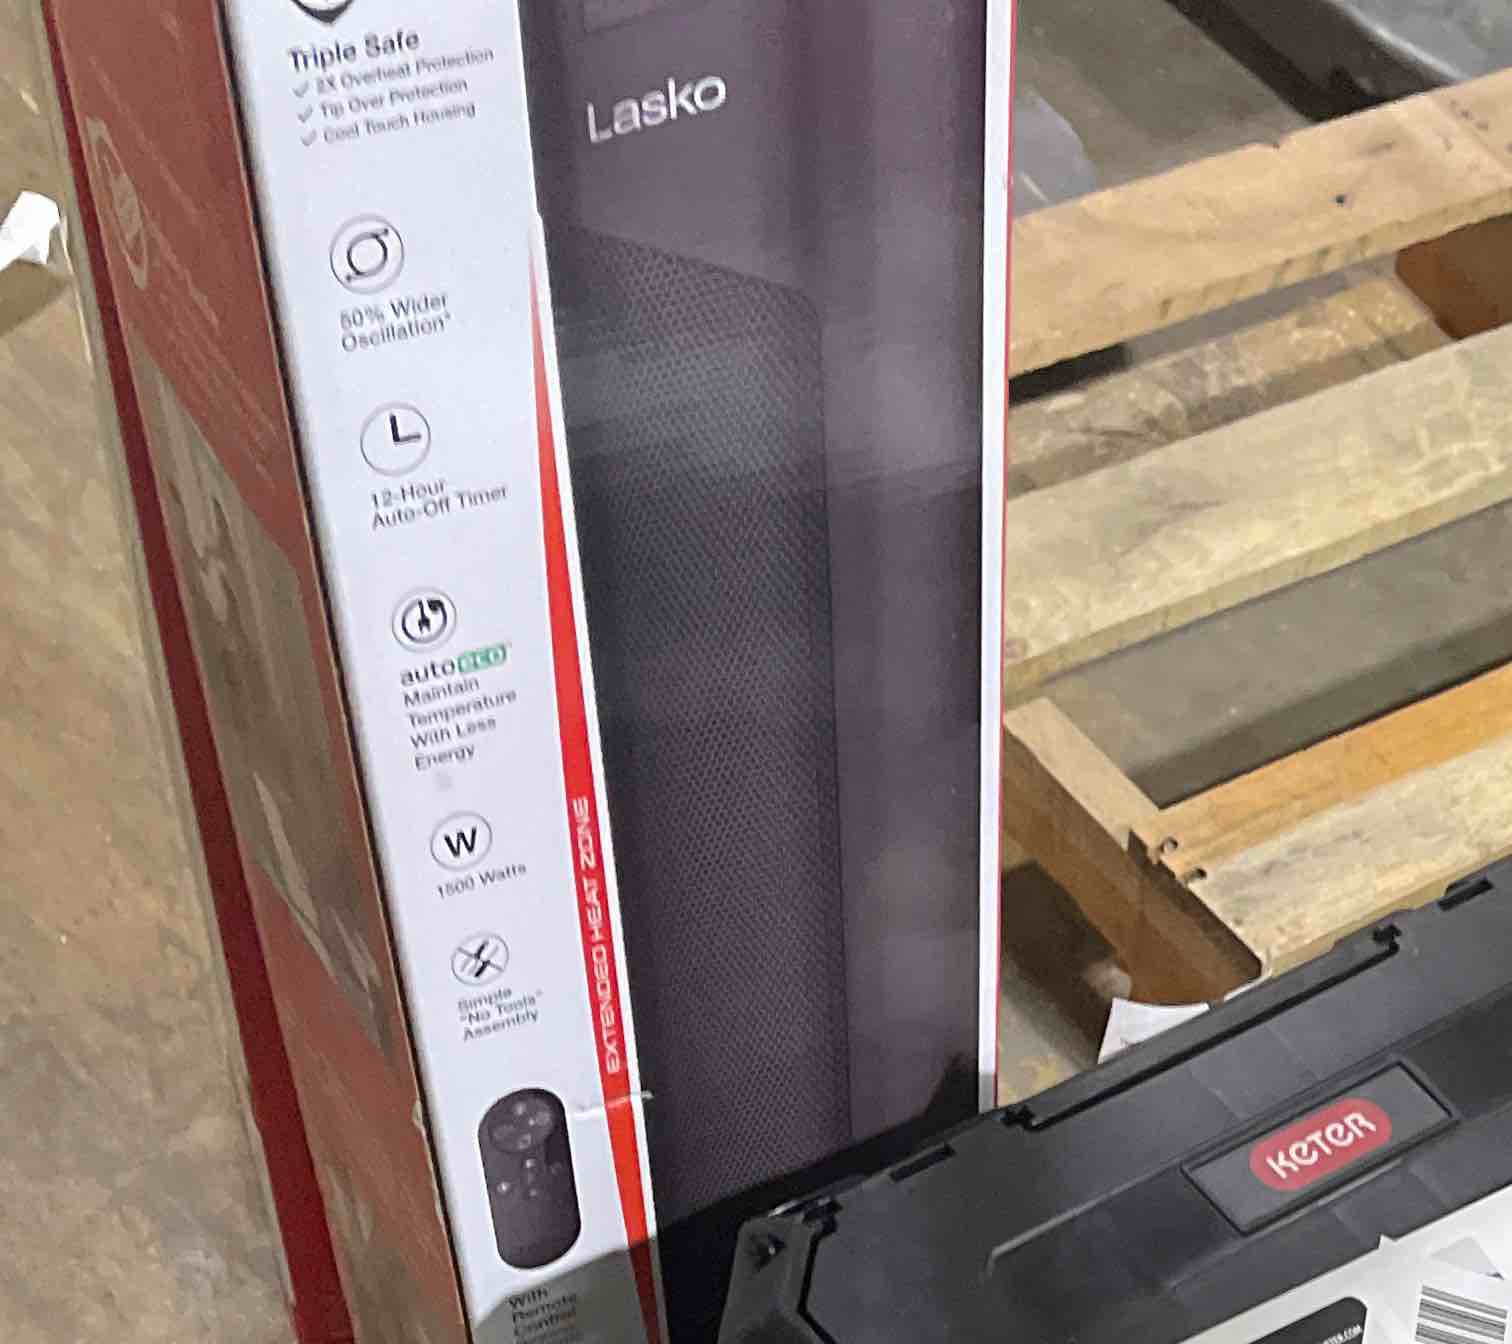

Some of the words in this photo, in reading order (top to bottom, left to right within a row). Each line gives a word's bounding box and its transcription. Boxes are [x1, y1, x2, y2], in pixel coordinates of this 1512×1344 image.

[288, 40, 357, 72] Triple
[364, 29, 420, 58] Safe
[340, 63, 412, 89] Overheat
[415, 46, 495, 75] Protection
[321, 101, 344, 118] Tip
[348, 95, 384, 113] Over
[389, 78, 469, 106] Protection
[585, 75, 728, 143] Lasko
[323, 124, 360, 144] Cool
[365, 115, 410, 135] Touch
[413, 102, 476, 125] Housing
[388, 294, 448, 318] Wider
[371, 480, 447, 509] 12-Hour
[372, 502, 450, 531] Auto-Off
[456, 485, 509, 510] Timer
[404, 677, 480, 707] Maintain
[407, 689, 517, 728] Temperature
[410, 725, 451, 750] With
[456, 716, 496, 739] Less
[414, 745, 476, 771] Energy
[444, 827, 477, 857] W
[572, 796, 596, 871] ZONE
[437, 877, 475, 899] 1500
[478, 863, 527, 887] Watts
[583, 875, 607, 942] HEAT
[463, 1009, 539, 1041] Assembly
[591, 943, 620, 1074] EXTENDED
[1266, 1111, 1376, 1180] KETER
